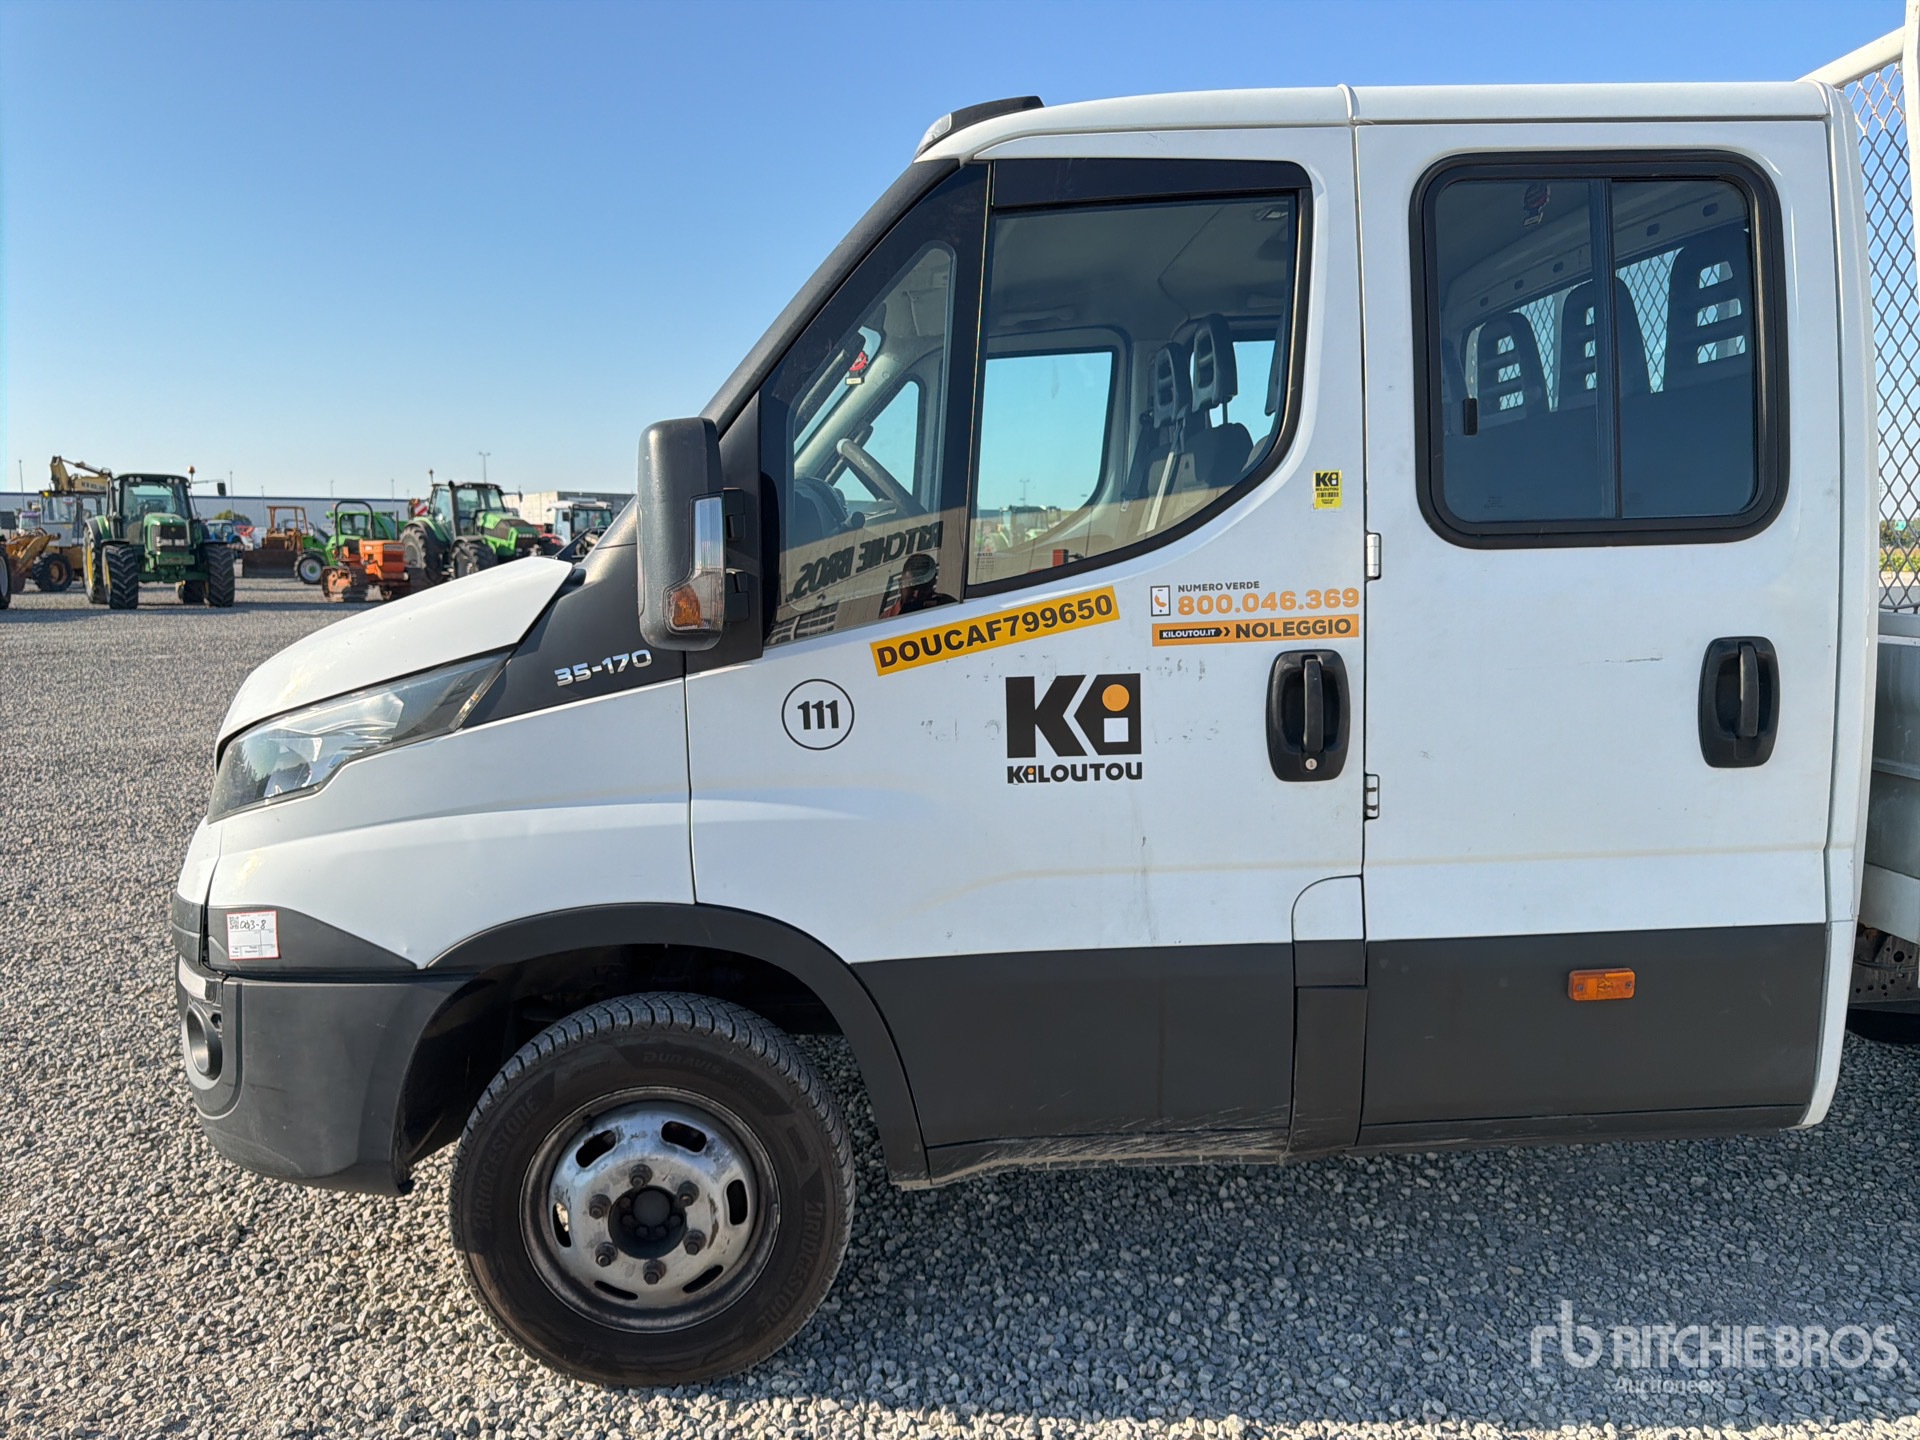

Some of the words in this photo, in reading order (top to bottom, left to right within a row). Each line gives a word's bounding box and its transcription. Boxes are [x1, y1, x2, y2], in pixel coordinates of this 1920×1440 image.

[1178, 583, 1223, 593] NUMERO
[1225, 581, 1260, 591] VERDE
[1178, 588, 1360, 616] 800.046.369
[876, 594, 1113, 668] DOUCAF799650
[1162, 628, 1216, 638] KILOUTOU.IT
[1235, 618, 1351, 639] NOLEGGIO
[554, 649, 652, 687] 35-170
[797, 700, 839, 730] 111
[471, 1094, 541, 1230] BRIDGESTONE
[757, 1199, 824, 1333] BRIDGESTONE
